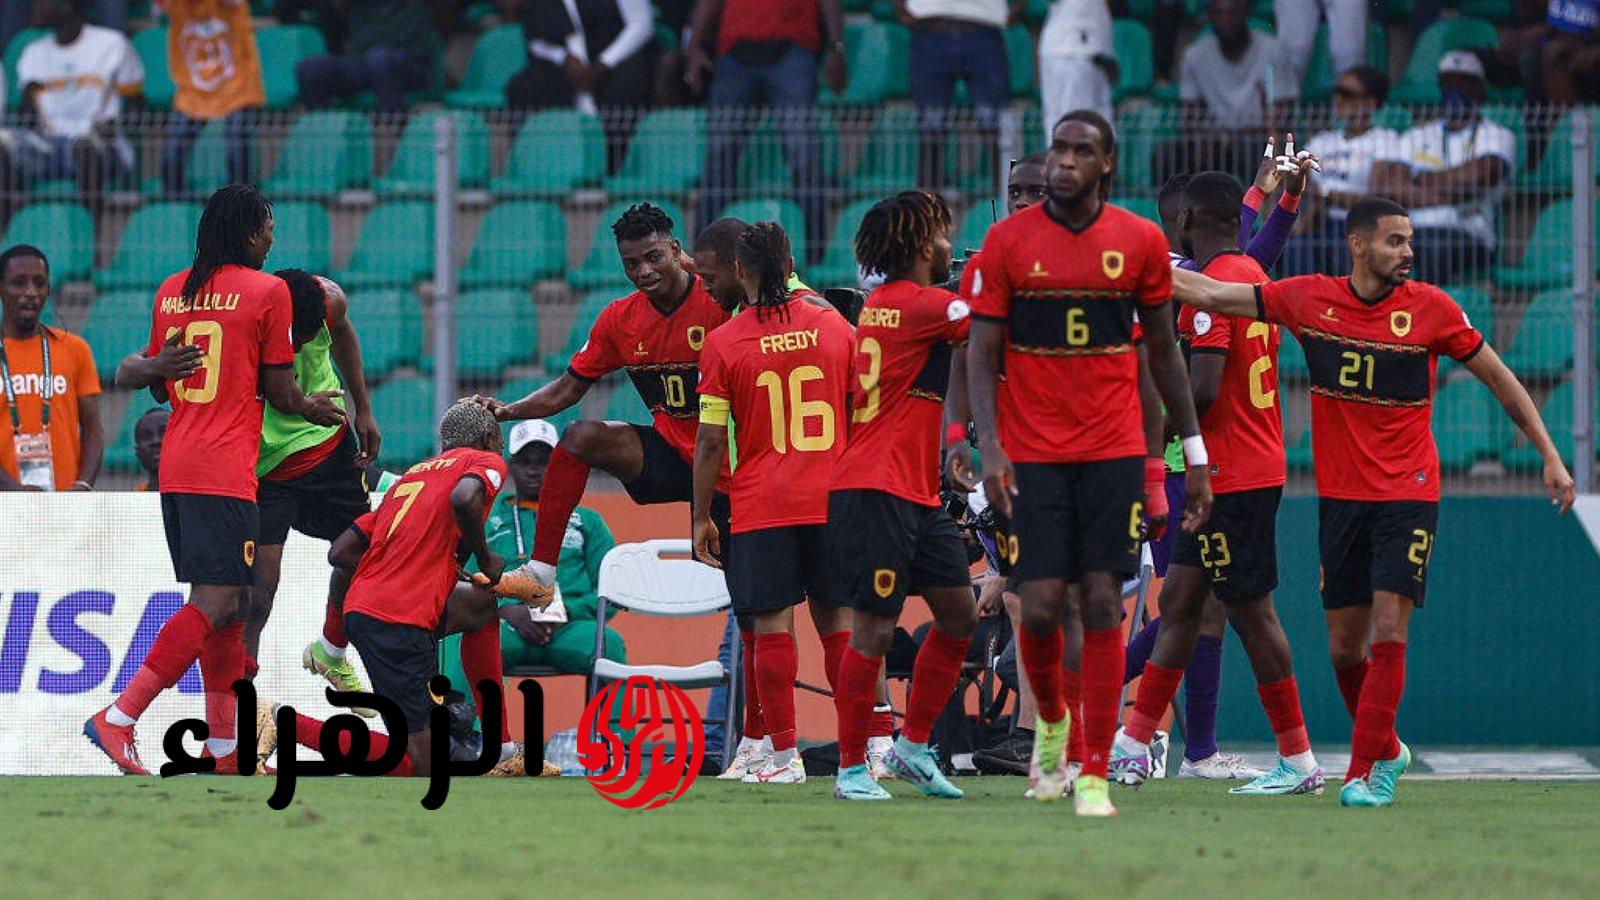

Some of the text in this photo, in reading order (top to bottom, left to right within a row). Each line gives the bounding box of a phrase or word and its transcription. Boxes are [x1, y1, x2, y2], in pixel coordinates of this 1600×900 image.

[760, 328, 819, 354] FREDY
[1066, 307, 1089, 346] 6
[1339, 351, 1375, 391] 21
[660, 374, 687, 408] 10
[756, 365, 835, 455] 16
[386, 481, 426, 541] 7
[1198, 532, 1232, 568] 23
[0, 590, 205, 694] ISA
